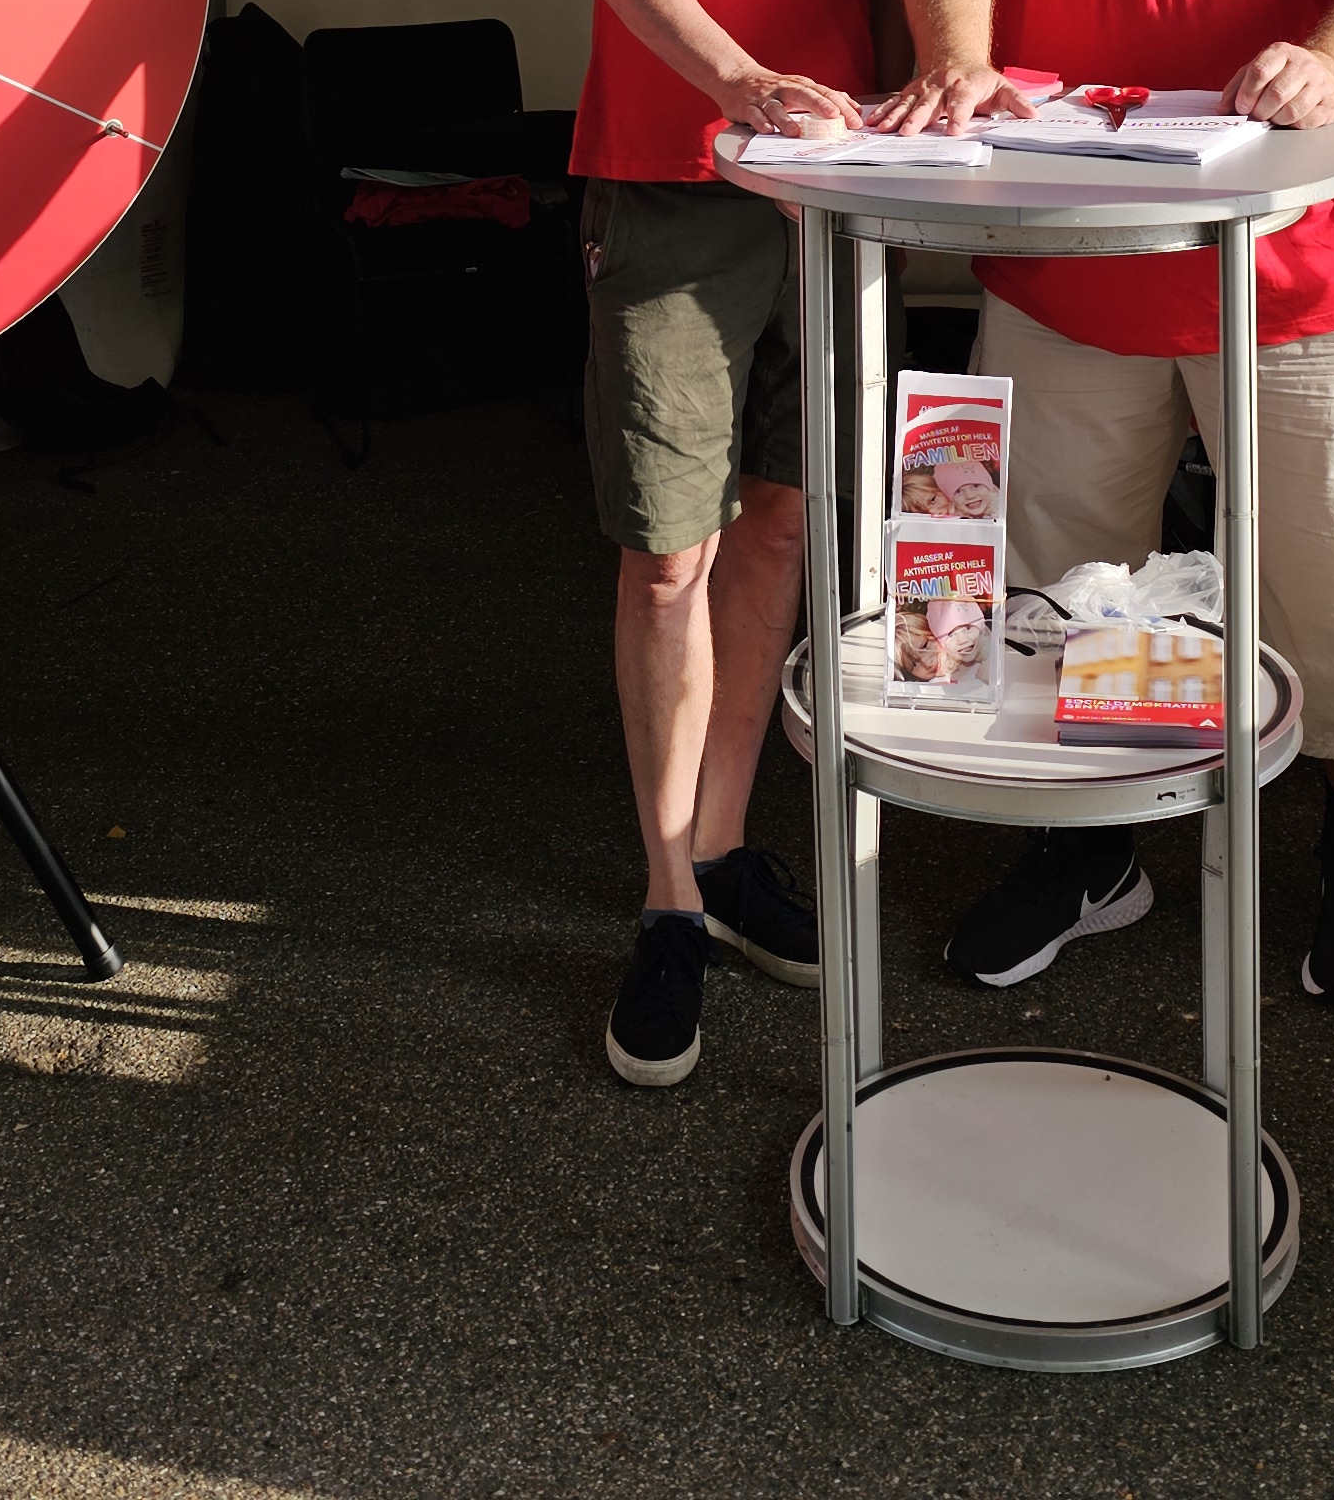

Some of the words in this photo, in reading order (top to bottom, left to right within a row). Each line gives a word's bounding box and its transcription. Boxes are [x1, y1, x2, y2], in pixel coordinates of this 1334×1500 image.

[919, 427, 950, 440] MASSER
[950, 426, 960, 434] AF
[909, 435, 957, 452] AKTIVITETER
[957, 434, 973, 442] FOR
[973, 433, 993, 441] HELE
[903, 442, 1001, 471] FAMILIEN
[913, 553, 944, 565] MASSER
[945, 551, 954, 560] AF
[903, 563, 950, 577] AKTIVITETER
[950, 562, 966, 571] FOR
[966, 559, 987, 569] HELE
[896, 571, 993, 605] FAMILIEN
[1064, 703, 1133, 711] GENTOFTE
[1065, 699, 1208, 710] SOCIALDEMOKRATIET
